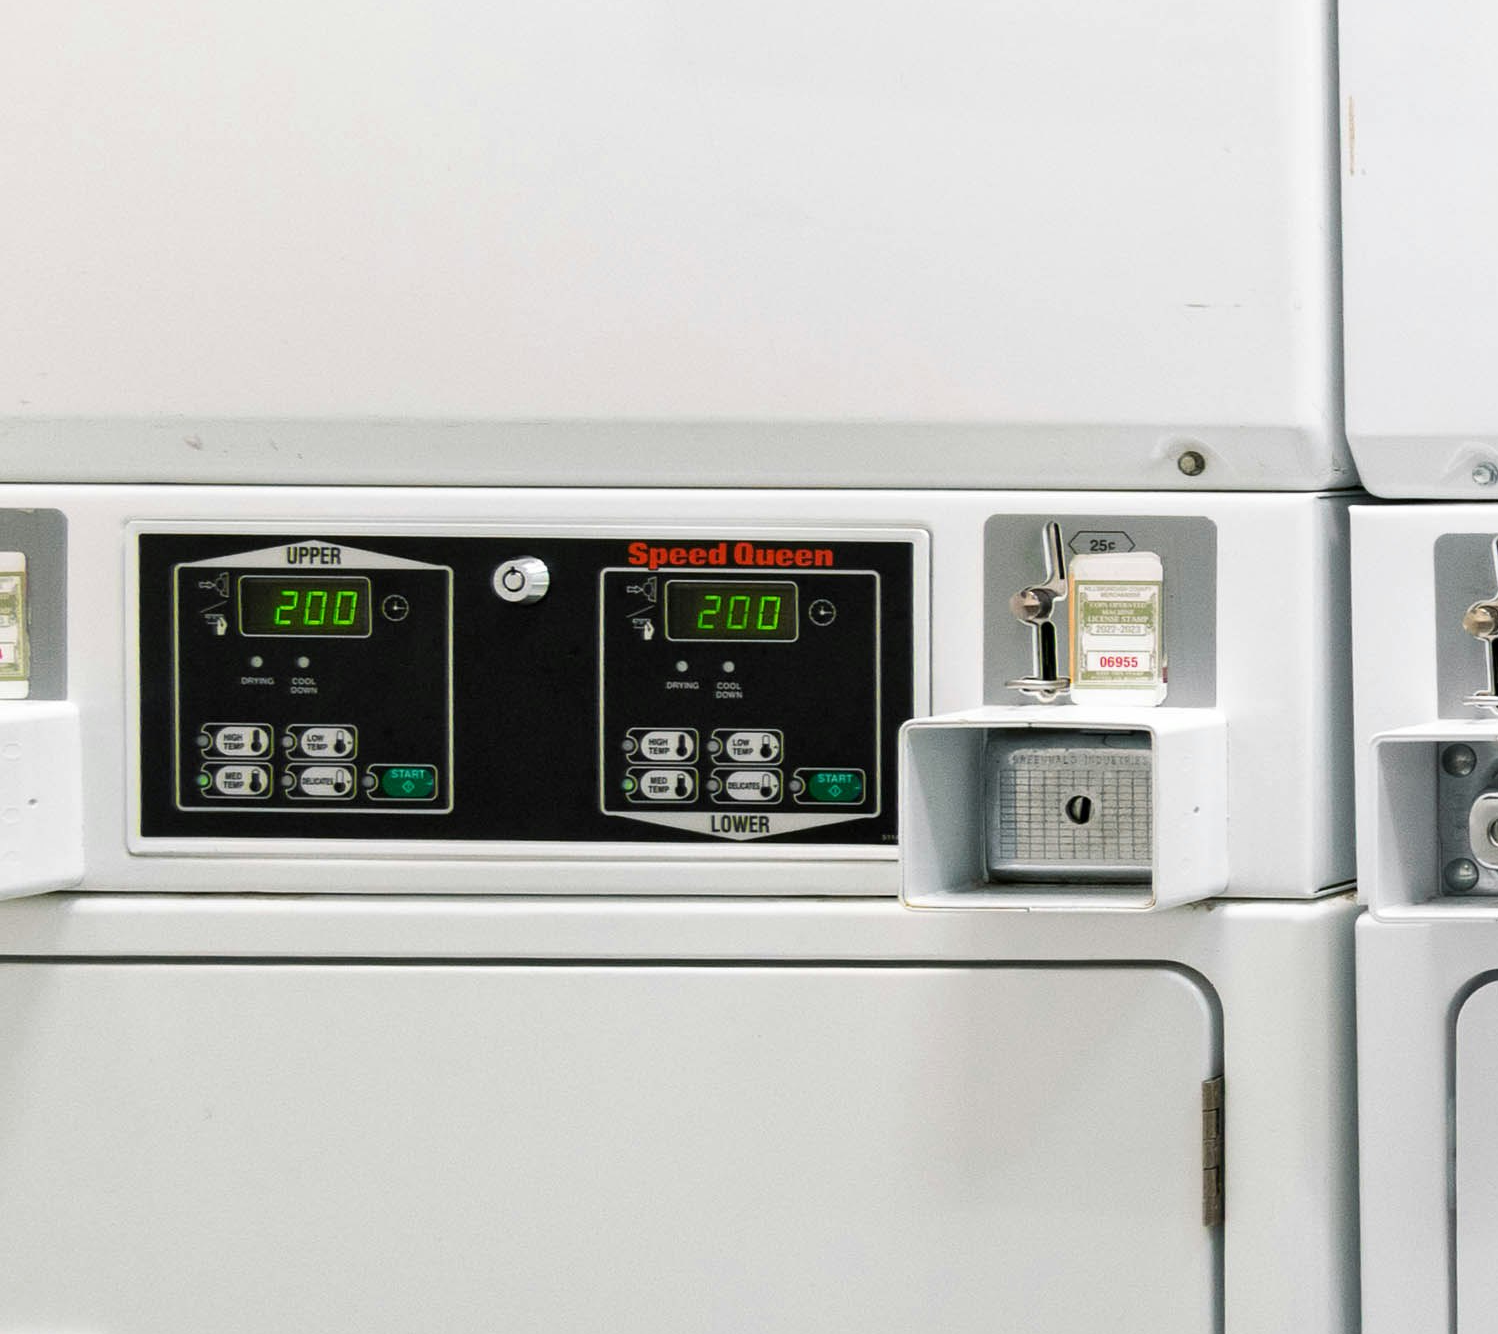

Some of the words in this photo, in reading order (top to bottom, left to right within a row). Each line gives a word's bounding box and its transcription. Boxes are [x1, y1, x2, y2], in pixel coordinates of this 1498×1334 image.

[287, 547, 341, 564] UPPER
[628, 542, 727, 570] Speed
[734, 543, 833, 566] Queen
[274, 591, 357, 624] 200
[698, 595, 781, 630] 200
[1100, 657, 1138, 667] 06955
[666, 682, 699, 690] DRYING
[733, 748, 753, 756] TEMP
[392, 770, 424, 778] START
[818, 774, 852, 783] START
[728, 782, 759, 790] DELICATES
[711, 815, 770, 833] LOWER
